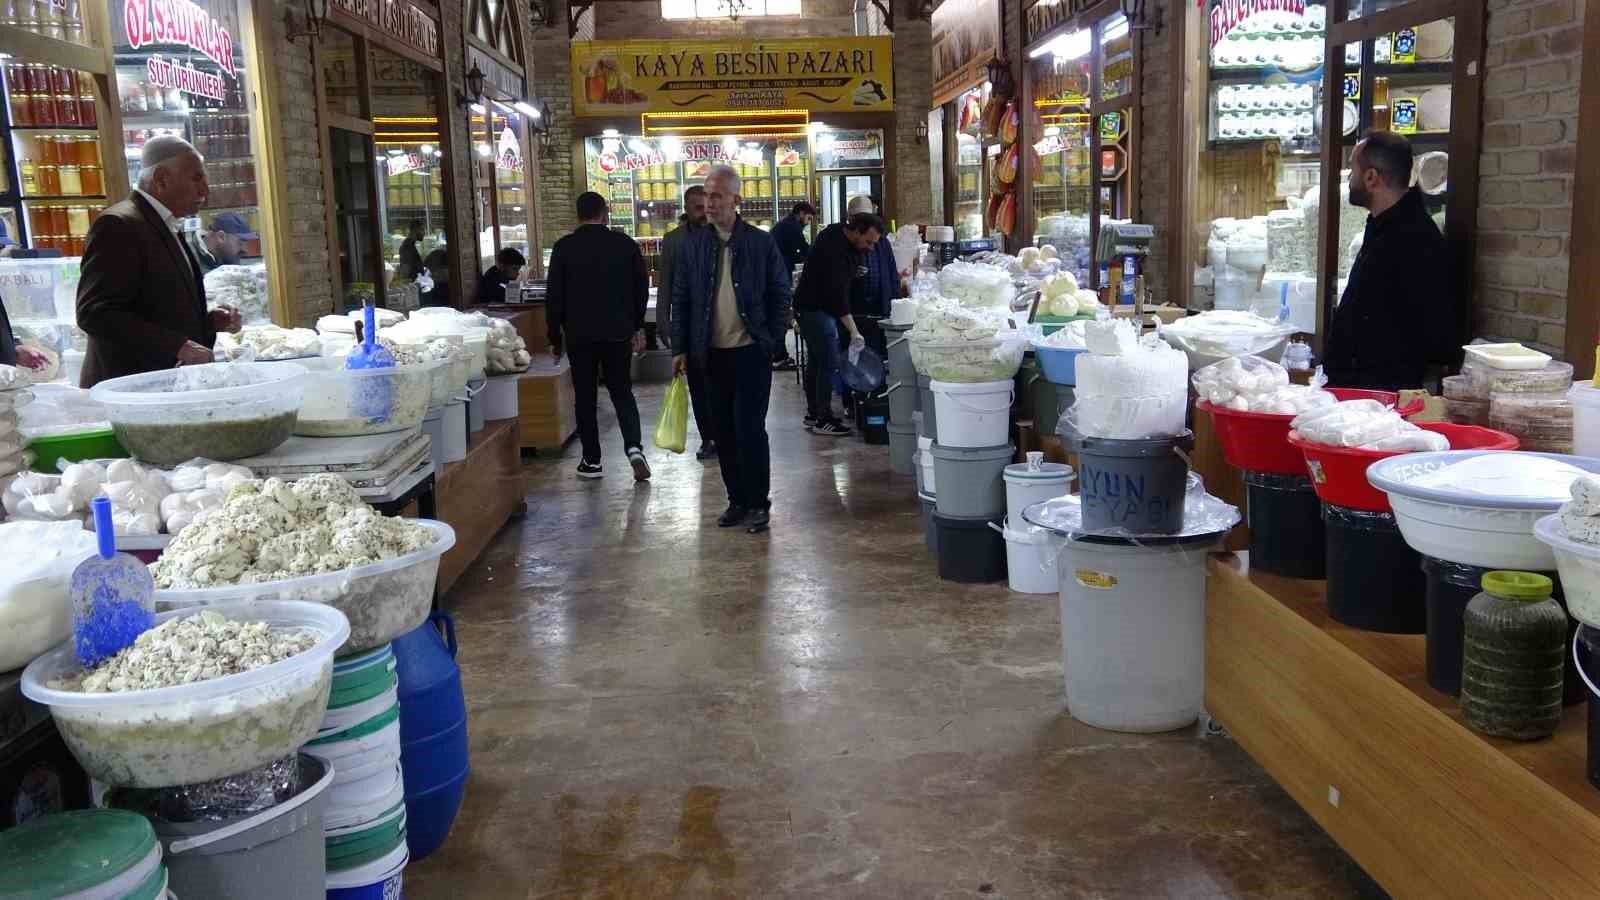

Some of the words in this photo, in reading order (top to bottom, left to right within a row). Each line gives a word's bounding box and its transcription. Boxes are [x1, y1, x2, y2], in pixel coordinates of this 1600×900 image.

[147, 53, 171, 89] SÜT
[634, 51, 706, 78] KAYA
[715, 45, 779, 76] BESİN
[786, 49, 875, 75] PAZARI
